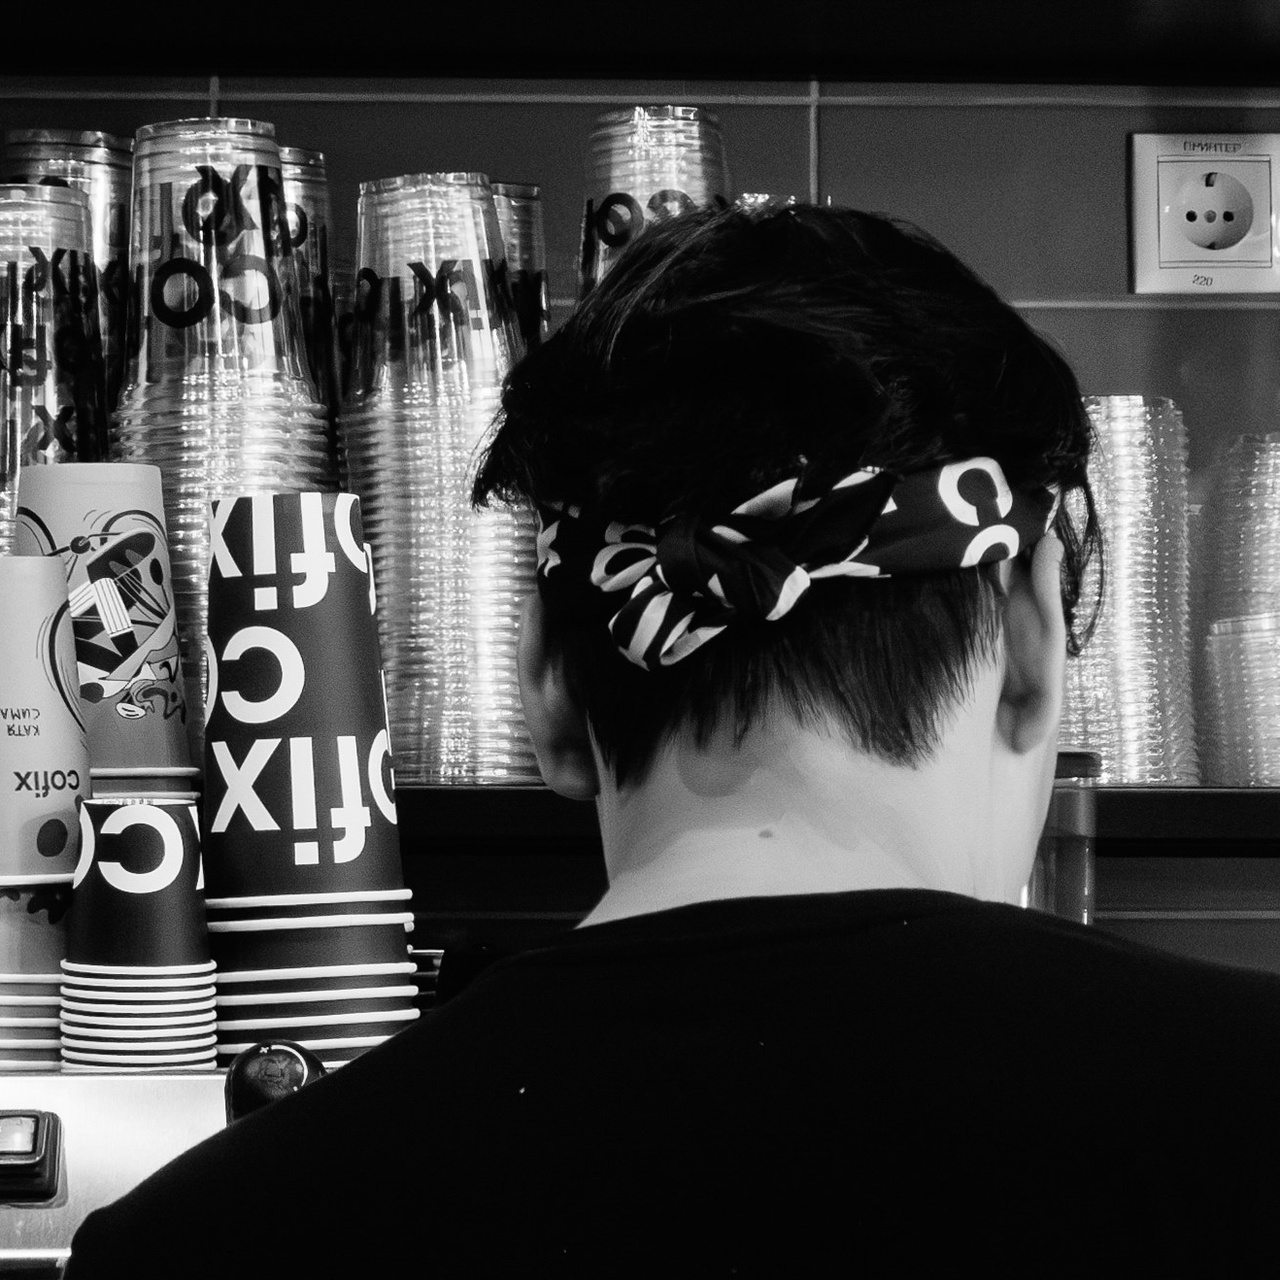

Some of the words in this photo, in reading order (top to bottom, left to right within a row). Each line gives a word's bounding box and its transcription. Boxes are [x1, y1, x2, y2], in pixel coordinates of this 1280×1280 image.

[1183, 140, 1242, 153] ПРИНТЕР
[1191, 274, 1214, 287] 220
[6, 723, 40, 737] КАТЯ
[13, 770, 80, 798] cofix
